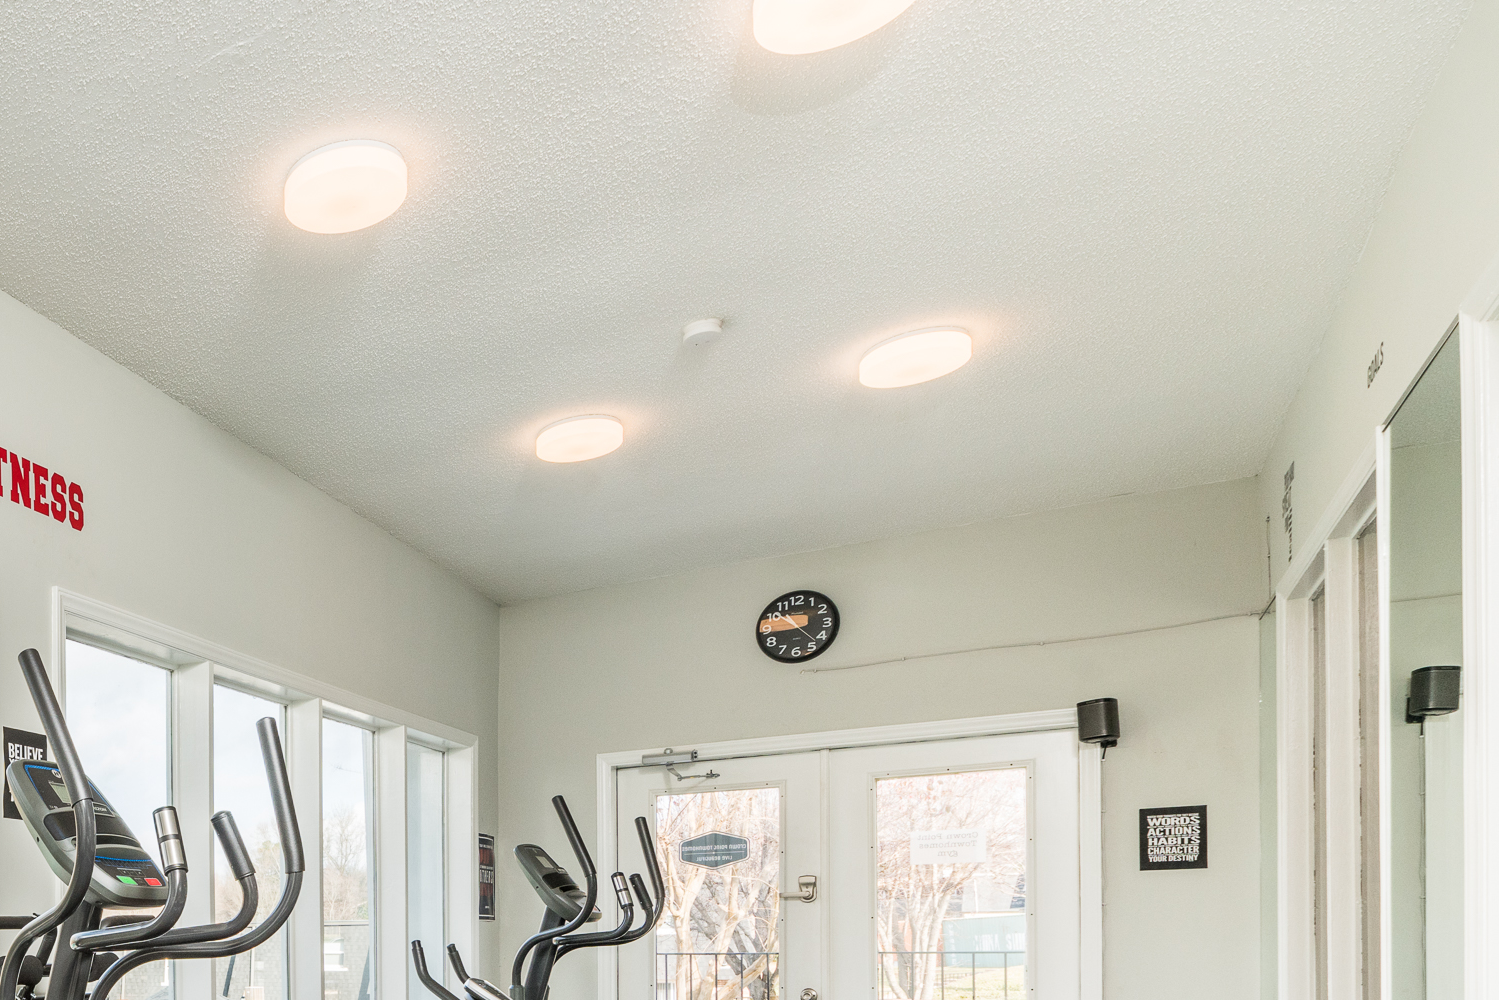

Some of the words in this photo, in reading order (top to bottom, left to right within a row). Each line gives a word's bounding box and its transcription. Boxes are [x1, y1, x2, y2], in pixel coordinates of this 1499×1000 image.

[790, 595, 804, 605] 12
[809, 597, 814, 606] 1
[777, 602, 788, 611] 11
[818, 604, 827, 614] 2
[767, 612, 780, 622] 10
[822, 617, 832, 627] 3
[762, 625, 771, 635] 9
[816, 630, 827, 640] 4
[766, 637, 776, 647] 8
[807, 642, 816, 651] 5
[778, 645, 787, 654] 7
[791, 647, 801, 656] 6
[8, 742, 43, 760] BELIEVE
[1147, 816, 1200, 826] WORDS
[1147, 826, 1200, 836] ACTIONS
[1148, 836, 1200, 846] HABITS
[1148, 846, 1199, 855] CHARACTER
[1168, 854, 1198, 862] DESTINY
